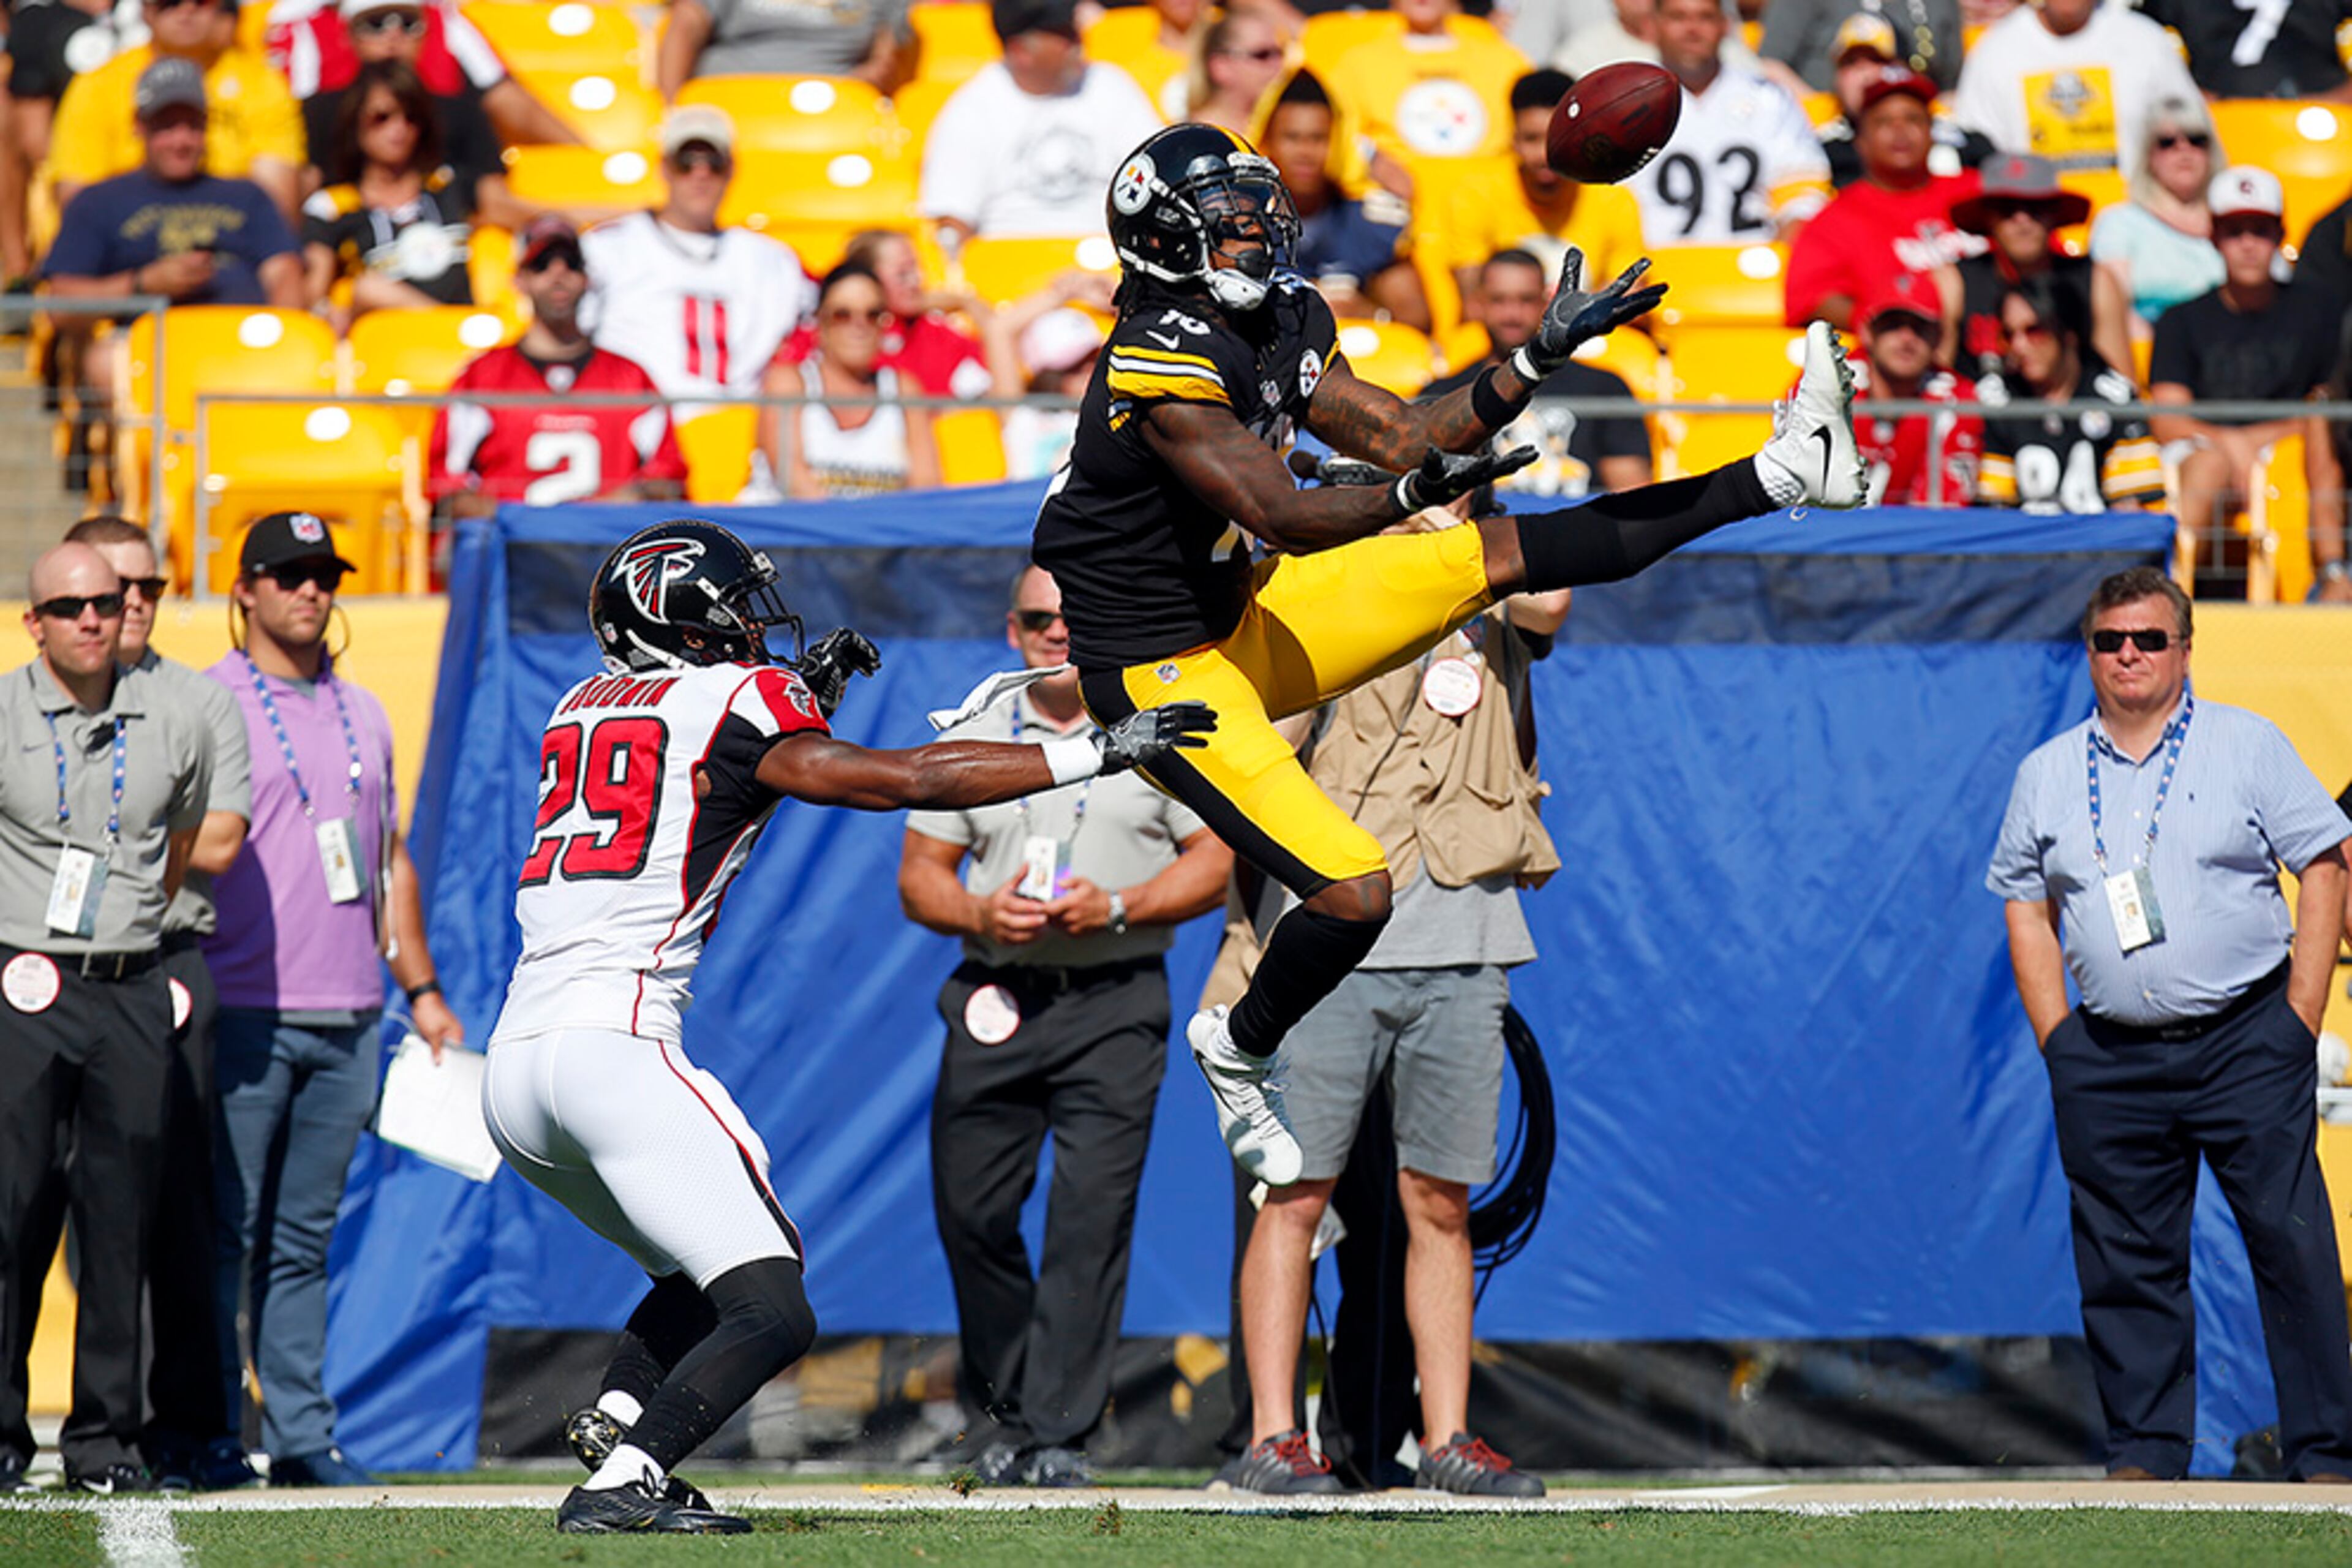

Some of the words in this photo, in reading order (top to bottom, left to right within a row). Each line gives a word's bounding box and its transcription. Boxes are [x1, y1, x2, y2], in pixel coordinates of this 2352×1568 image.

[2231, 0, 2292, 66] 7
[1657, 146, 1763, 234] 92
[681, 294, 730, 386] 11
[524, 431, 601, 508] 2
[519, 715, 670, 888] 29
